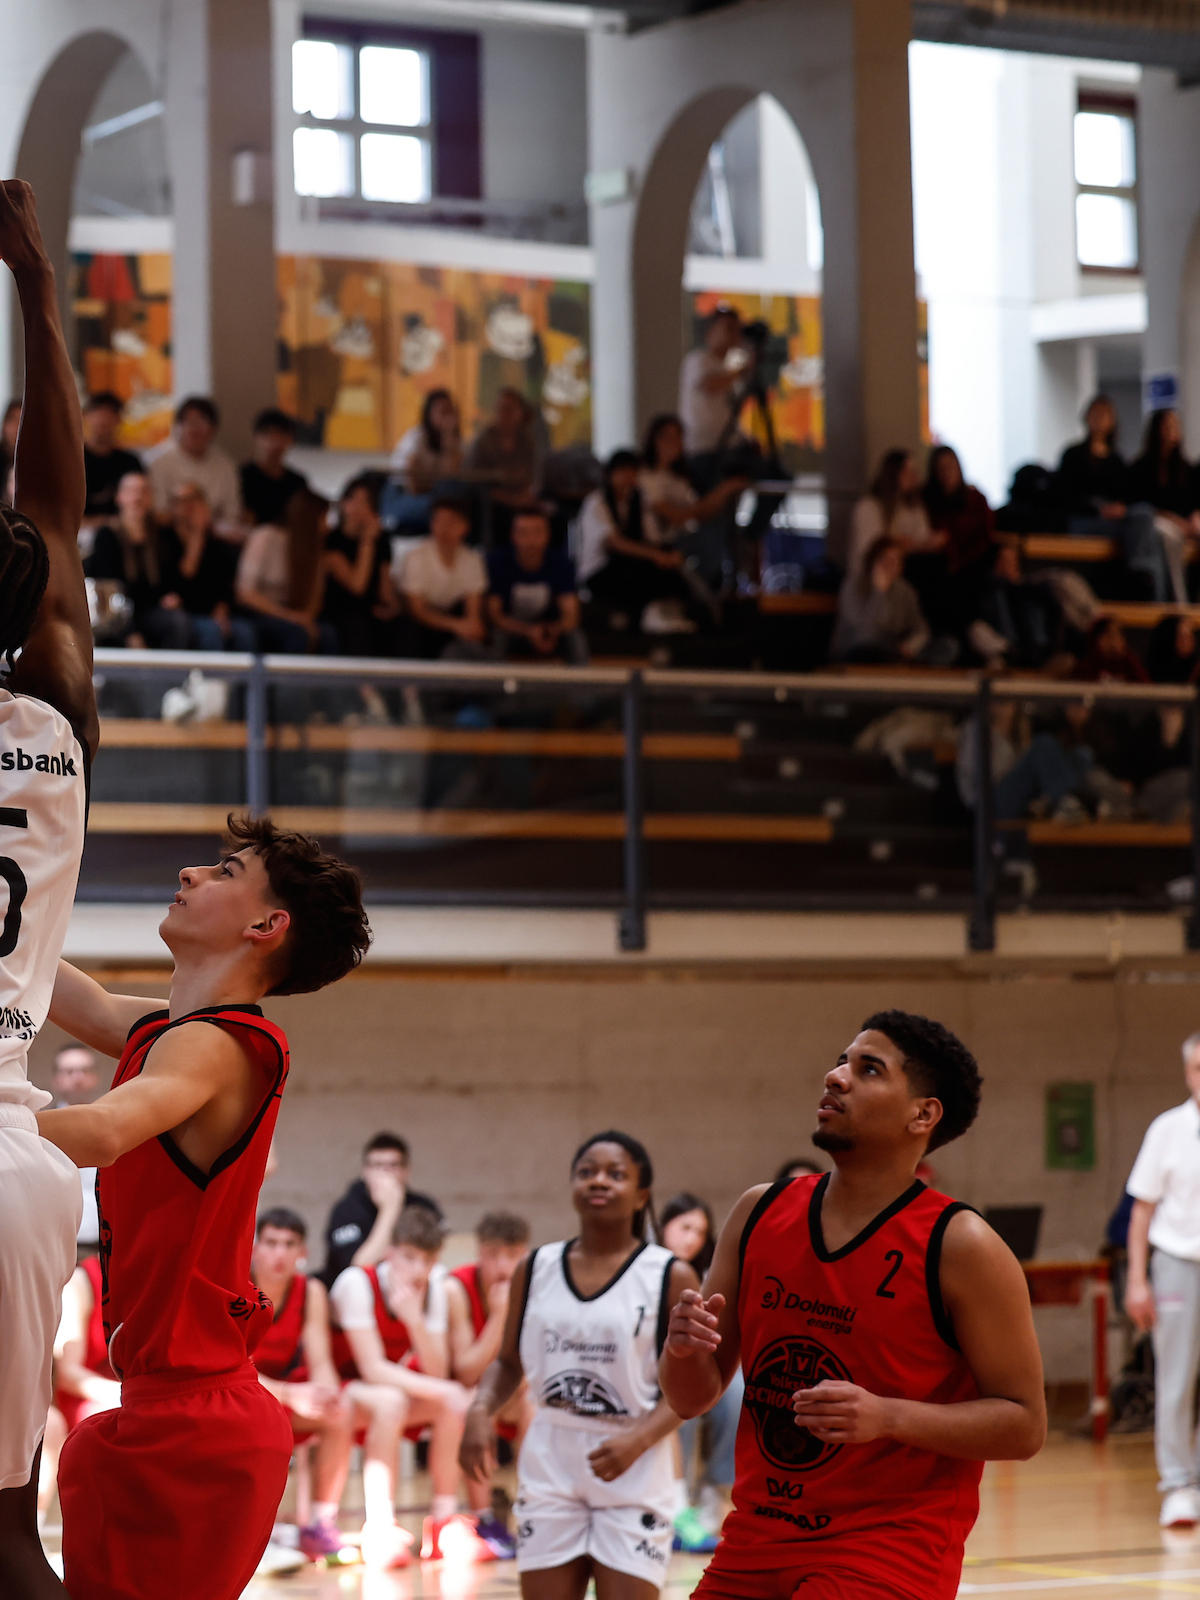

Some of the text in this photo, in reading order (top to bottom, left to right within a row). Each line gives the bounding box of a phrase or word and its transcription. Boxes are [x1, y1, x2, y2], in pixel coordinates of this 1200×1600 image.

[876, 1249, 904, 1299] 2
[784, 1292, 858, 1323] Dolomiti
[806, 1317, 852, 1335] energia
